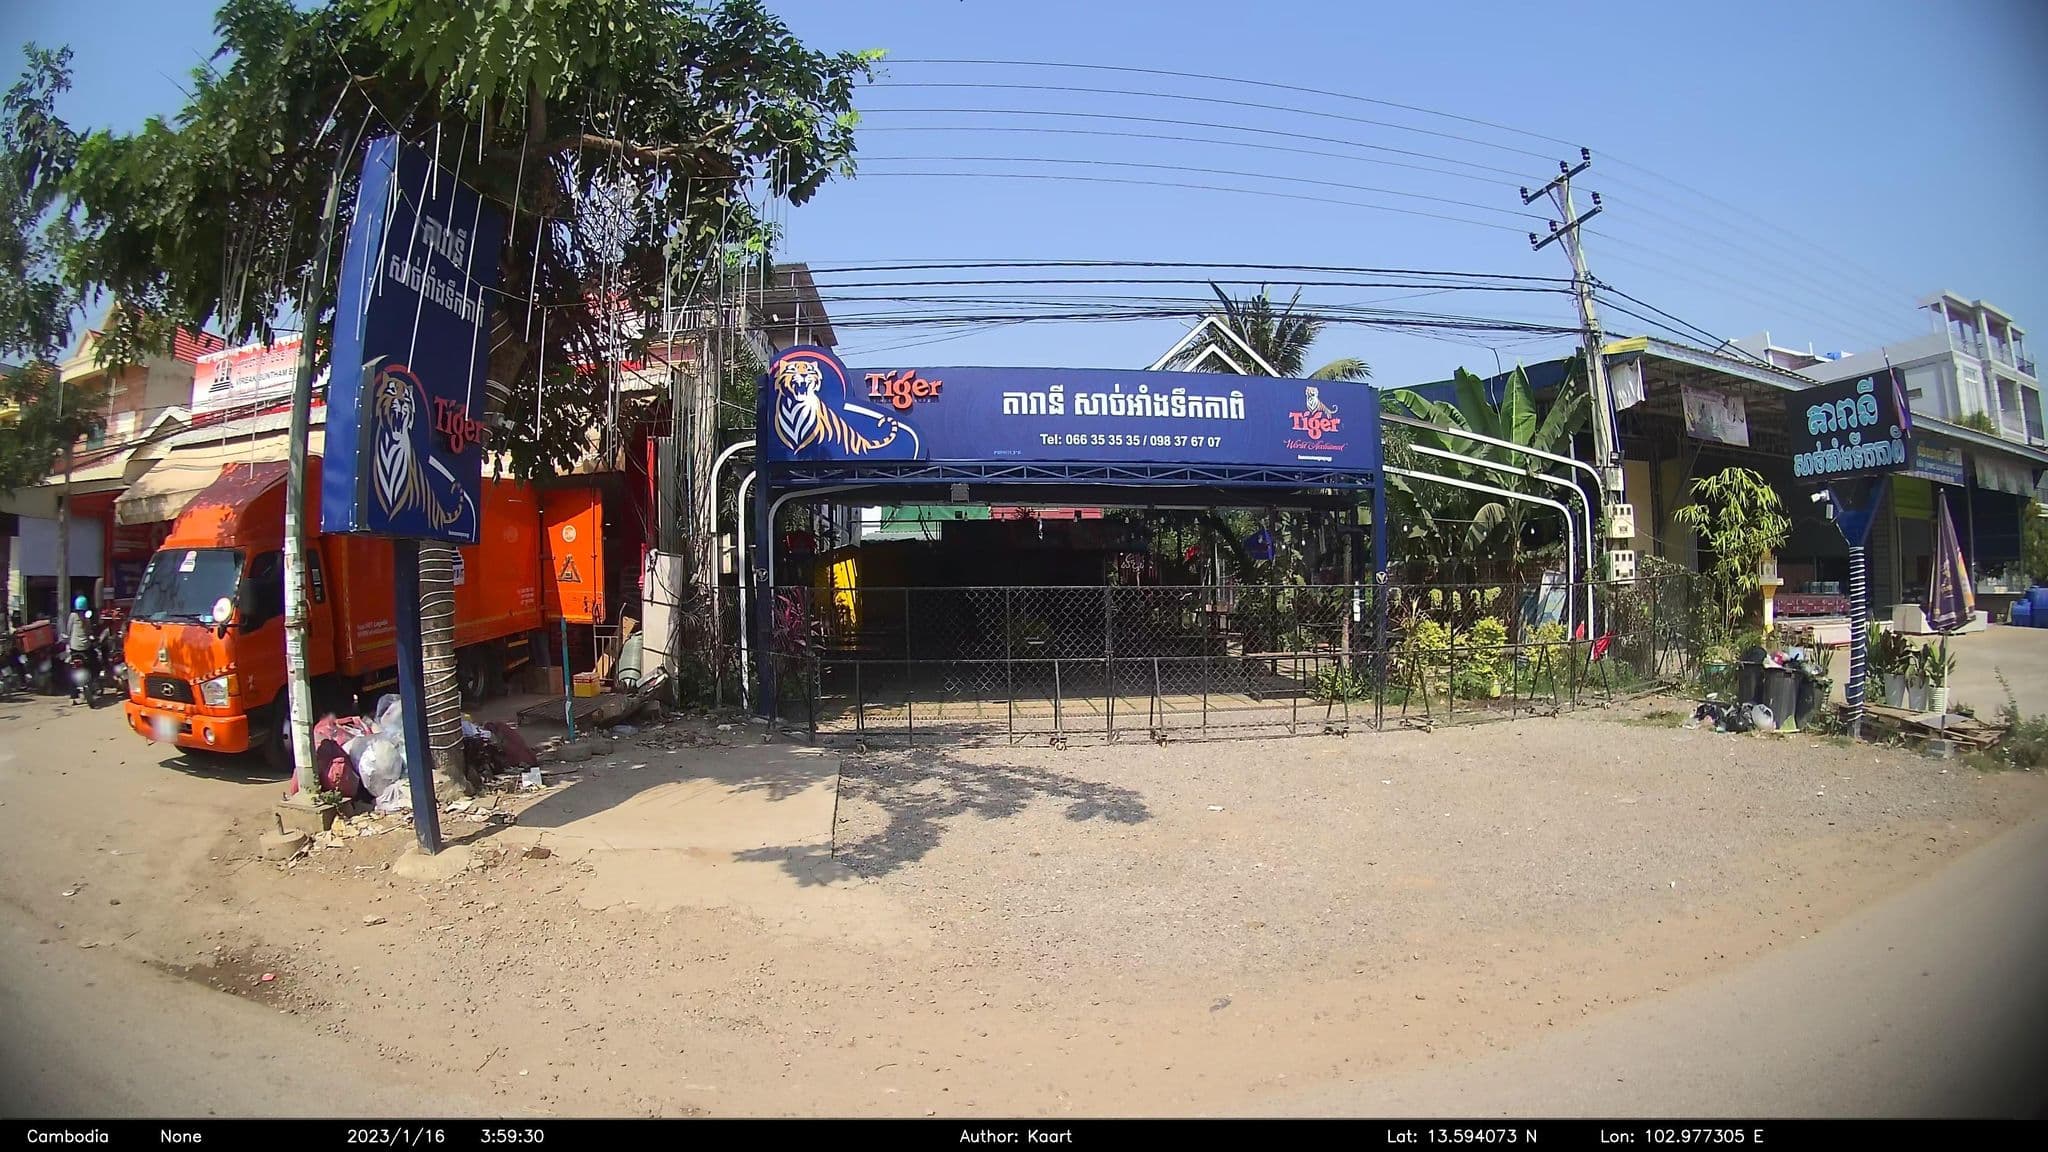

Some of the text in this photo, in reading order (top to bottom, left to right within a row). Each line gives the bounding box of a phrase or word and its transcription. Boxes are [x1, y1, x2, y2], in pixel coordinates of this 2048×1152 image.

[865, 370, 944, 410] Tiger
[1003, 384, 1066, 416] តារានី
[434, 395, 486, 454] Tiger
[1040, 433, 1222, 448] Tel: 066 35 35 35 / 098 37 67 07
[1289, 411, 1341, 440] Tiger
